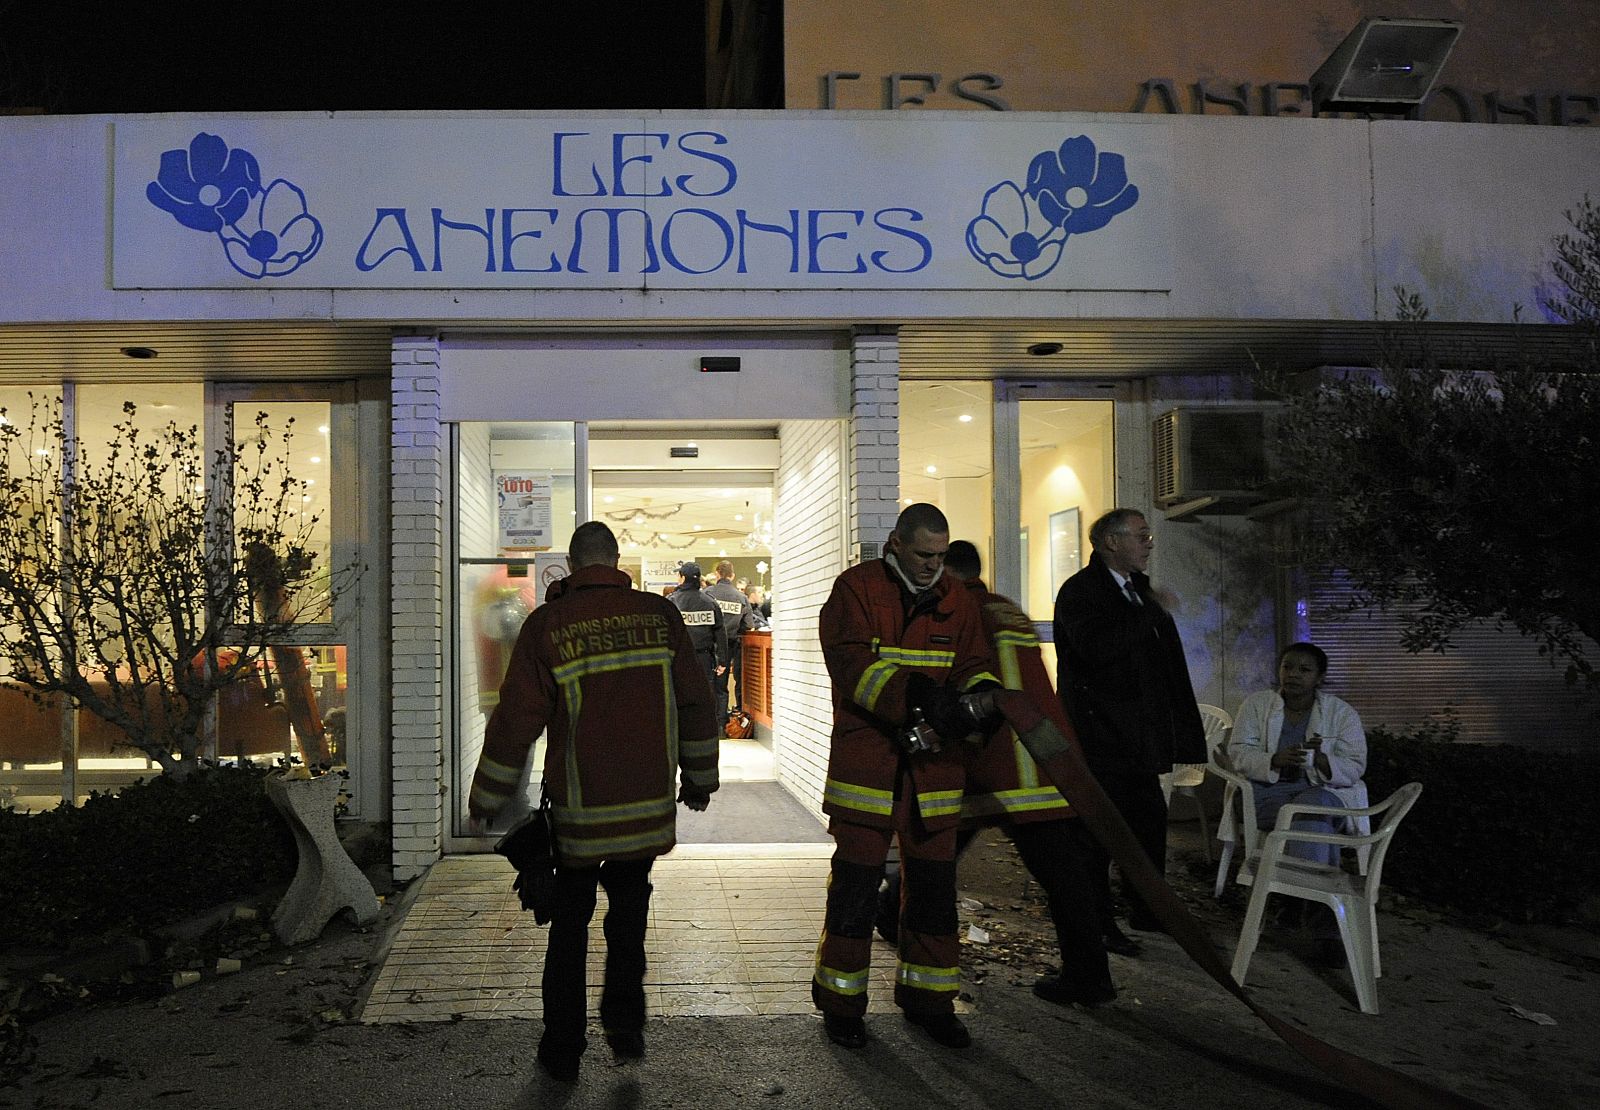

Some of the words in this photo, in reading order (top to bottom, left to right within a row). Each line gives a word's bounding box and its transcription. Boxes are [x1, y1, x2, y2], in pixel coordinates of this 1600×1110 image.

[552, 131, 738, 197] LES
[354, 207, 933, 275] ANEMONES
[504, 479, 533, 493] LOTO
[559, 628, 668, 660] MARSEILLE
